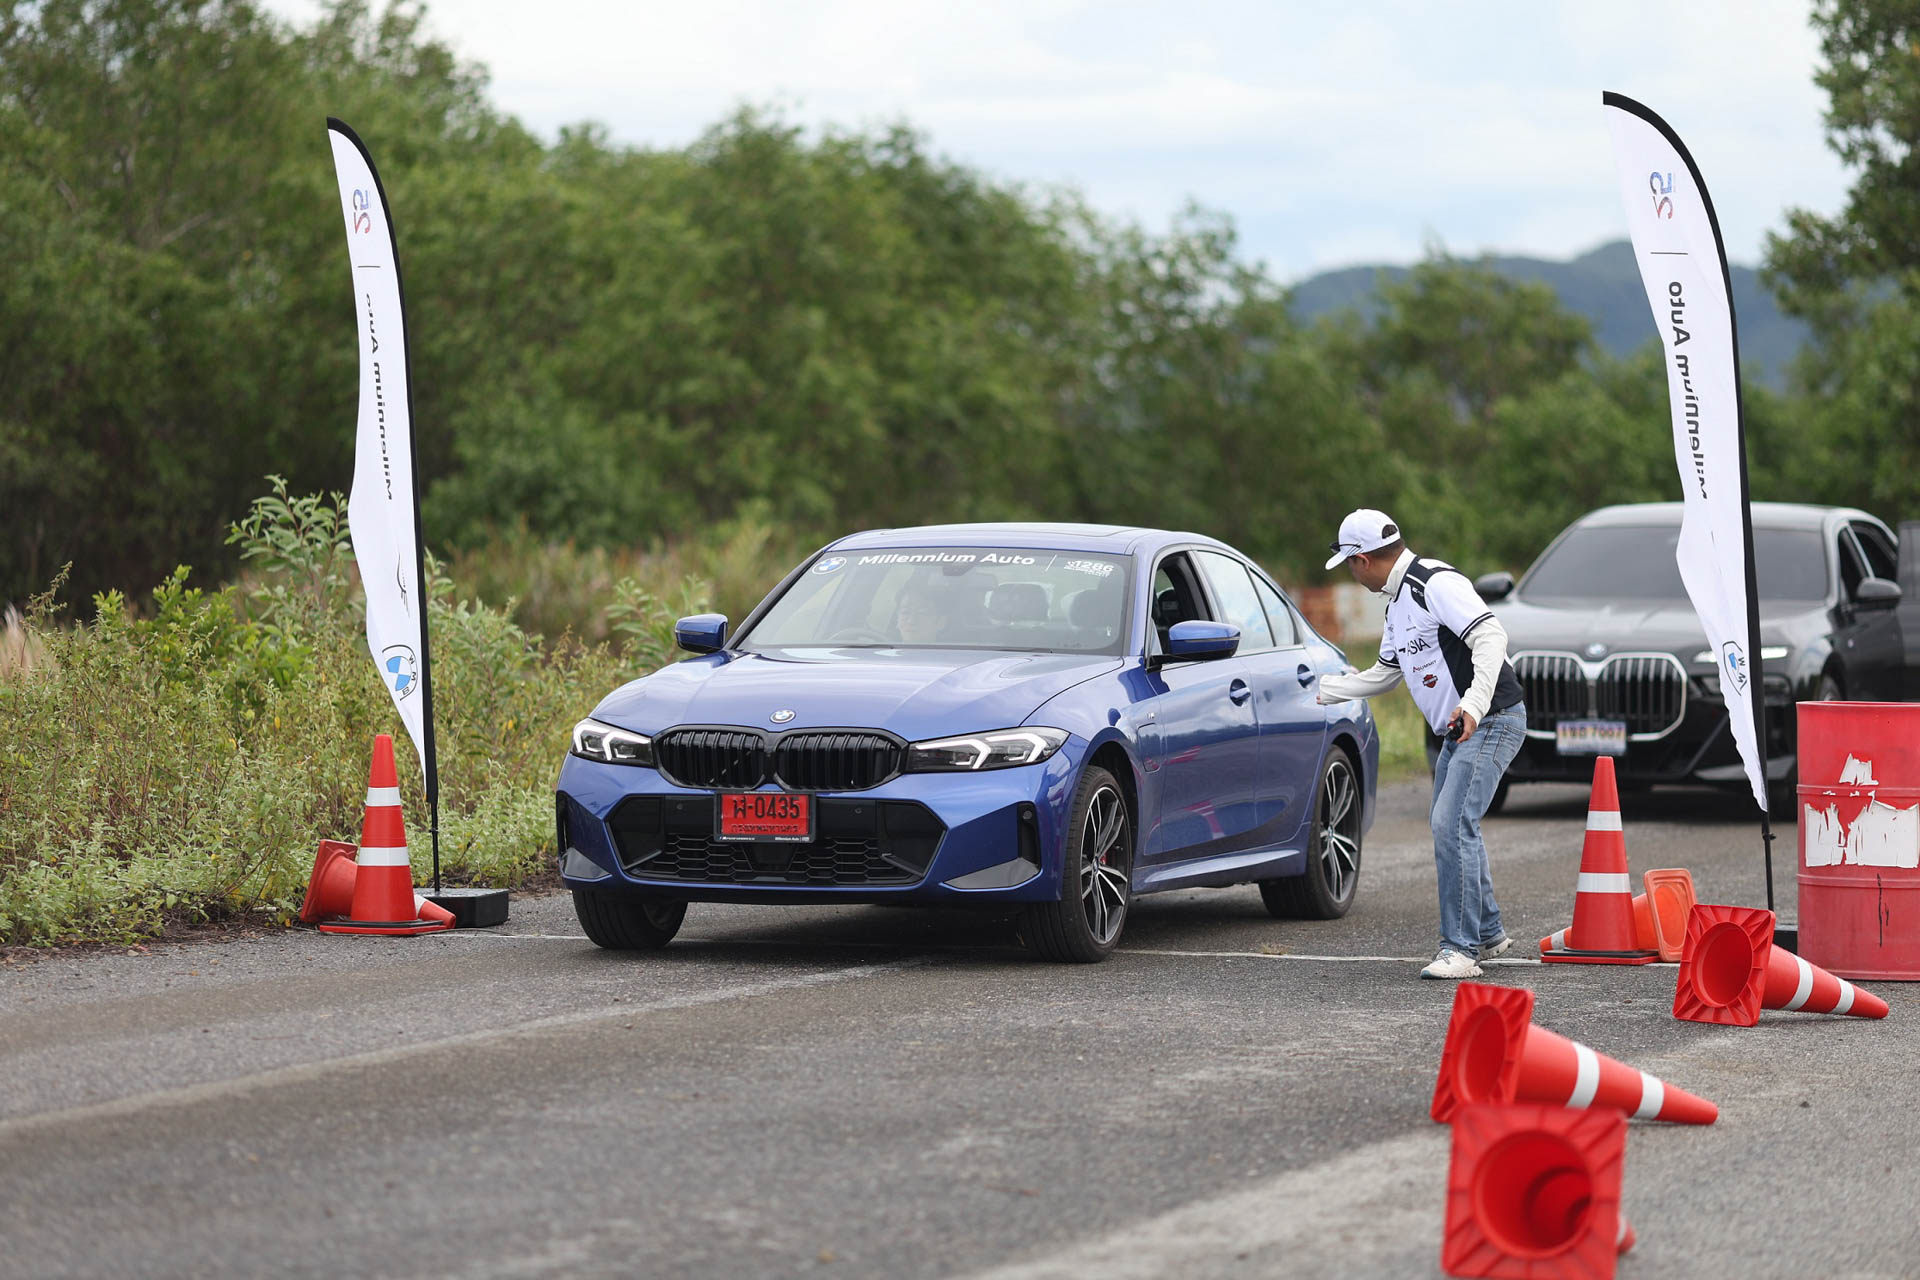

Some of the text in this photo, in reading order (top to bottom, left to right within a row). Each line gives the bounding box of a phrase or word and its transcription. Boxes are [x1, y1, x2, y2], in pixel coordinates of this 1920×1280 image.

[858, 552, 977, 566] Millennium
[980, 552, 1036, 566] Auto
[1073, 560, 1115, 572] 1286
